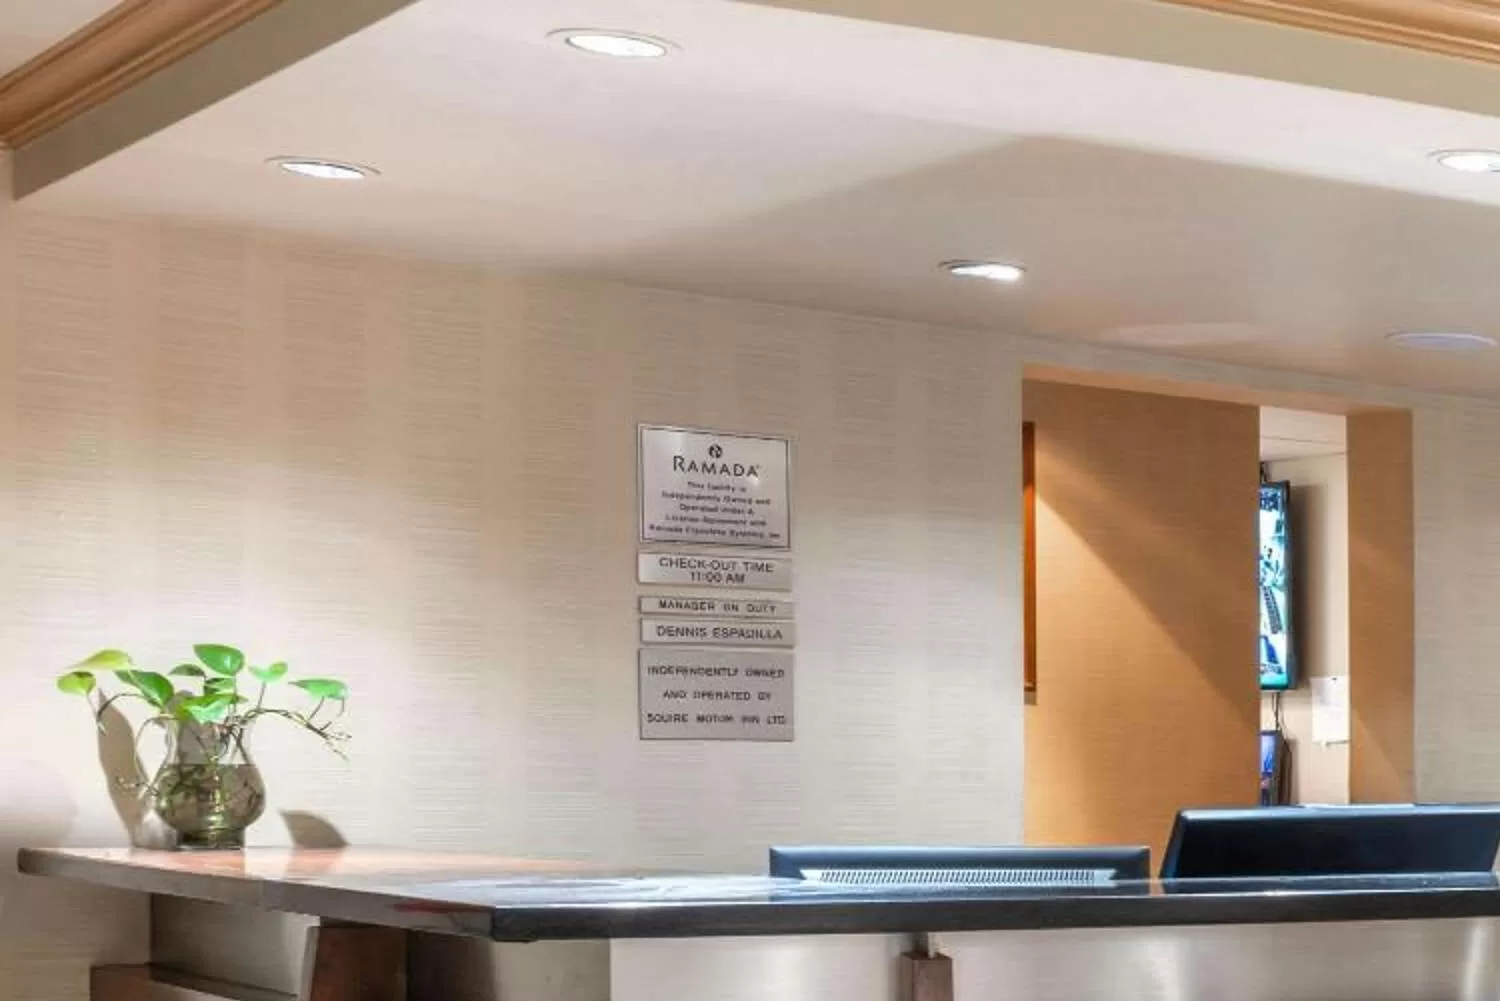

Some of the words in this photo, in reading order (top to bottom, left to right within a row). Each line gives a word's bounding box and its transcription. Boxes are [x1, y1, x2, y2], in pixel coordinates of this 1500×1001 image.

[673, 455, 758, 477] RAMADA
[659, 556, 737, 571] CHECK-OUT
[743, 561, 775, 573] TIME
[690, 571, 721, 583] 11:00
[726, 573, 745, 584] AM
[659, 599, 715, 611] MANAGER
[723, 602, 739, 612] ON
[747, 603, 777, 613] DUTY
[657, 625, 707, 637] DENNIS
[648, 665, 739, 677] INDEPENDENTLY
[745, 667, 785, 678] OWNED
[663, 689, 687, 699] AND
[693, 691, 750, 701] OPERATED
[758, 691, 771, 701] BY
[647, 713, 688, 723] SQUIRE
[696, 714, 733, 723] MOTOR
